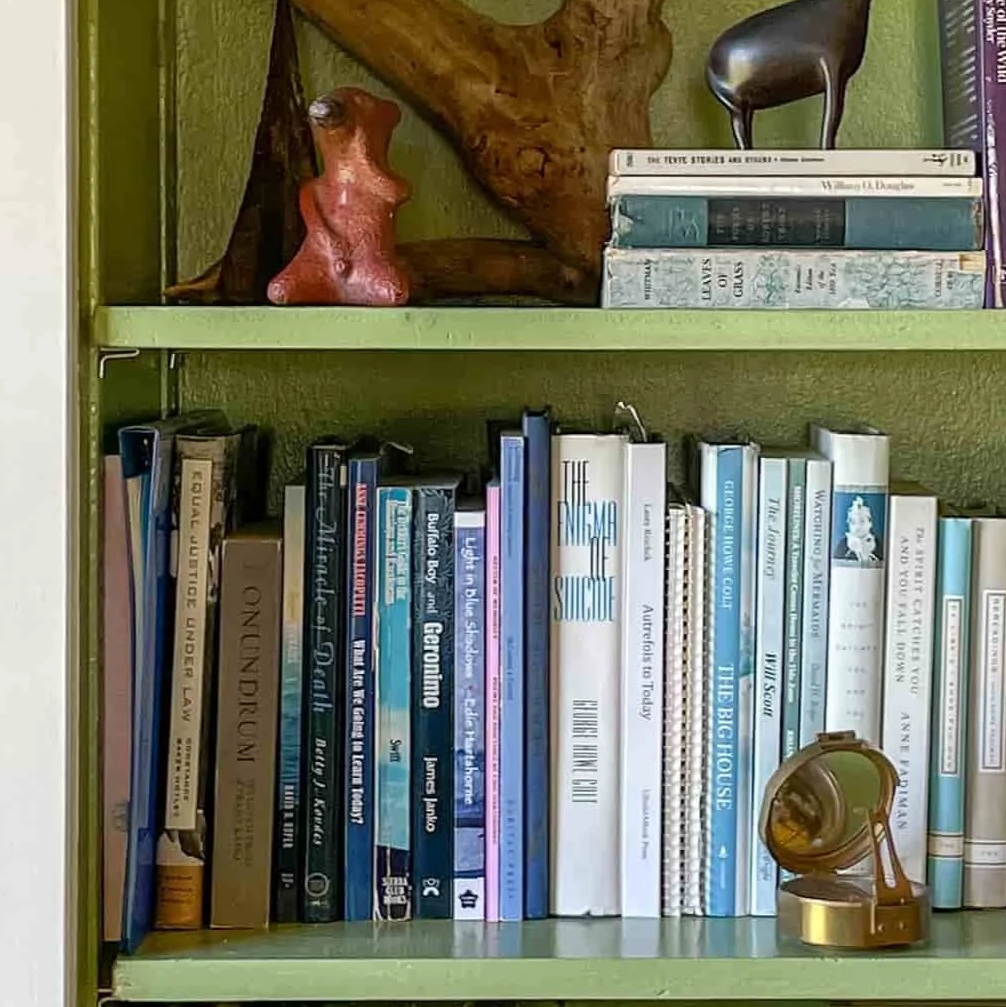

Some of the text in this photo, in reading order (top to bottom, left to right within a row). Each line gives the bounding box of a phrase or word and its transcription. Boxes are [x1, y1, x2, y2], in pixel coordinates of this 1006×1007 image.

[701, 258, 712, 300] LEAVES
[717, 273, 728, 288] OF
[732, 261, 744, 298] GRASS
[557, 500, 617, 546] ENIGMA
[562, 459, 590, 506] THE
[180, 471, 203, 723] EQUAL JUSTICE UNDER LAW
[553, 576, 615, 622] SUICIDE
[589, 536, 610, 582] OF
[716, 481, 735, 811] GEORGE HOWE COLT THE BIG HOUSE
[762, 497, 781, 718] The Journey Will Scott
[422, 512, 442, 832] Buffalo Boy and Geronimo James Janko
[462, 537, 478, 805] Light in Blue Shadows Edie Hartshorne
[640, 604, 655, 721] Autrefois to Today
[897, 712, 911, 830] ANNE FADIMAN
